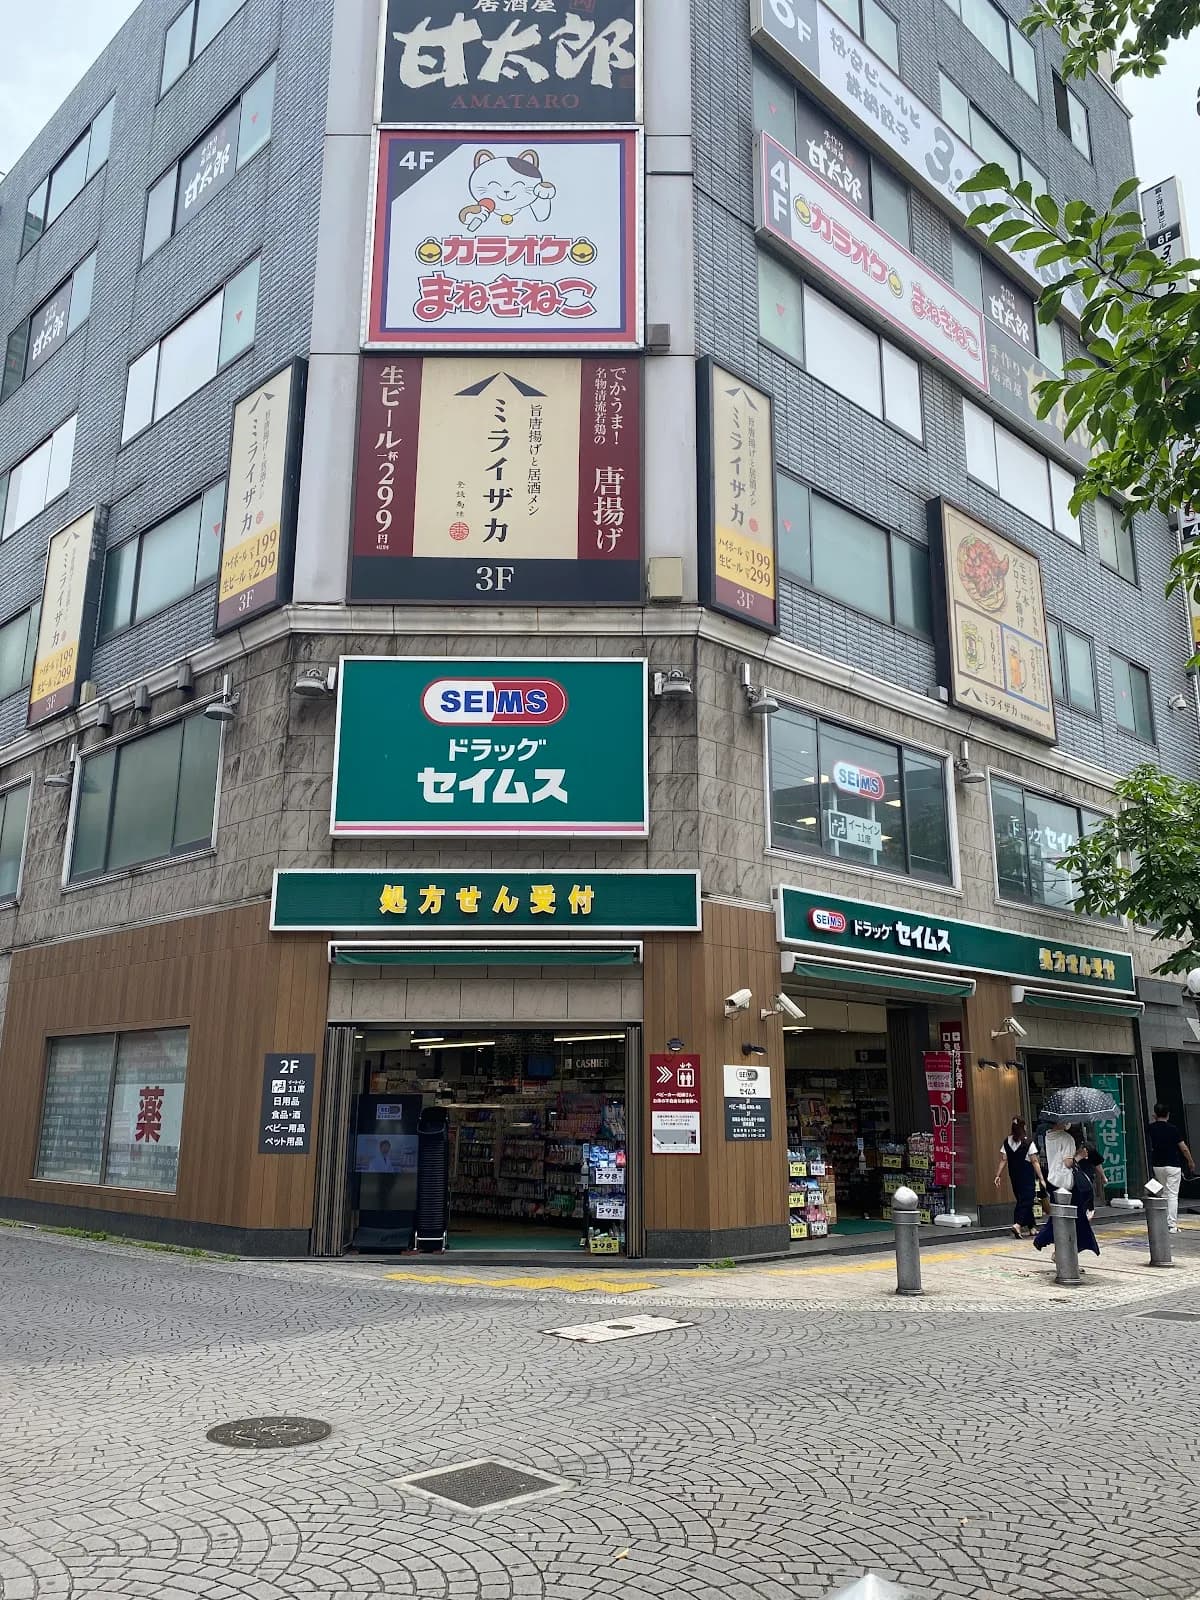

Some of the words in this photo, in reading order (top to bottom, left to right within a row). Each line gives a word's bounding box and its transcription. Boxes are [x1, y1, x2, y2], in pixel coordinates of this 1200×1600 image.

[393, 12, 635, 89] 甘太郎
[452, 94, 580, 109] AMATARO
[399, 151, 434, 170] 4F
[807, 139, 862, 203] 甘太郎
[770, 160, 788, 222] 4F
[442, 235, 573, 265] カラオケ
[811, 203, 888, 284] カラオケ
[1157, 231, 1172, 244] 6F
[413, 271, 597, 321] まねきねこ
[912, 281, 980, 361] まねきねこ
[989, 295, 1030, 345] 甘太郎
[374, 365, 405, 450] 生ビール
[594, 367, 607, 445] 名物清流若鶏の
[482, 398, 514, 543] ミライザカ
[527, 403, 543, 517] 旨唐揚げと居酒メシ
[729, 406, 745, 527] ミライザカ
[241, 419, 257, 536] ミライザカ
[593, 465, 625, 553] 唐揚げ
[719, 553, 743, 573] 生ビール
[475, 566, 514, 591] 3F
[52, 553, 70, 649] ミライザカ
[238, 589, 255, 612] 3F
[736, 589, 755, 609] 3F
[45, 693, 57, 711] 3F
[440, 689, 548, 714] SEIMS
[983, 692, 1018, 717] ミライザカ
[449, 738, 547, 762] ドラッグ
[417, 767, 568, 804] セイムス
[838, 768, 879, 793] SEIMS
[849, 820, 880, 836] イートイン
[379, 884, 595, 915] 処方せん受付
[816, 914, 842, 927] SEIMS
[854, 919, 892, 939] ドラッグ
[896, 920, 951, 953] セイムス
[1039, 947, 1115, 981] 処方せん受付
[280, 1060, 300, 1074] 2F
[575, 1058, 609, 1069] CASHIER
[273, 1096, 300, 1106] 日用品
[288, 1085, 305, 1094] 11席
[135, 1086, 165, 1143] 薬
[265, 1123, 306, 1133] ベビー用品
[271, 1110, 301, 1120] 食品・酒
[265, 1136, 304, 1147] ペット用品
